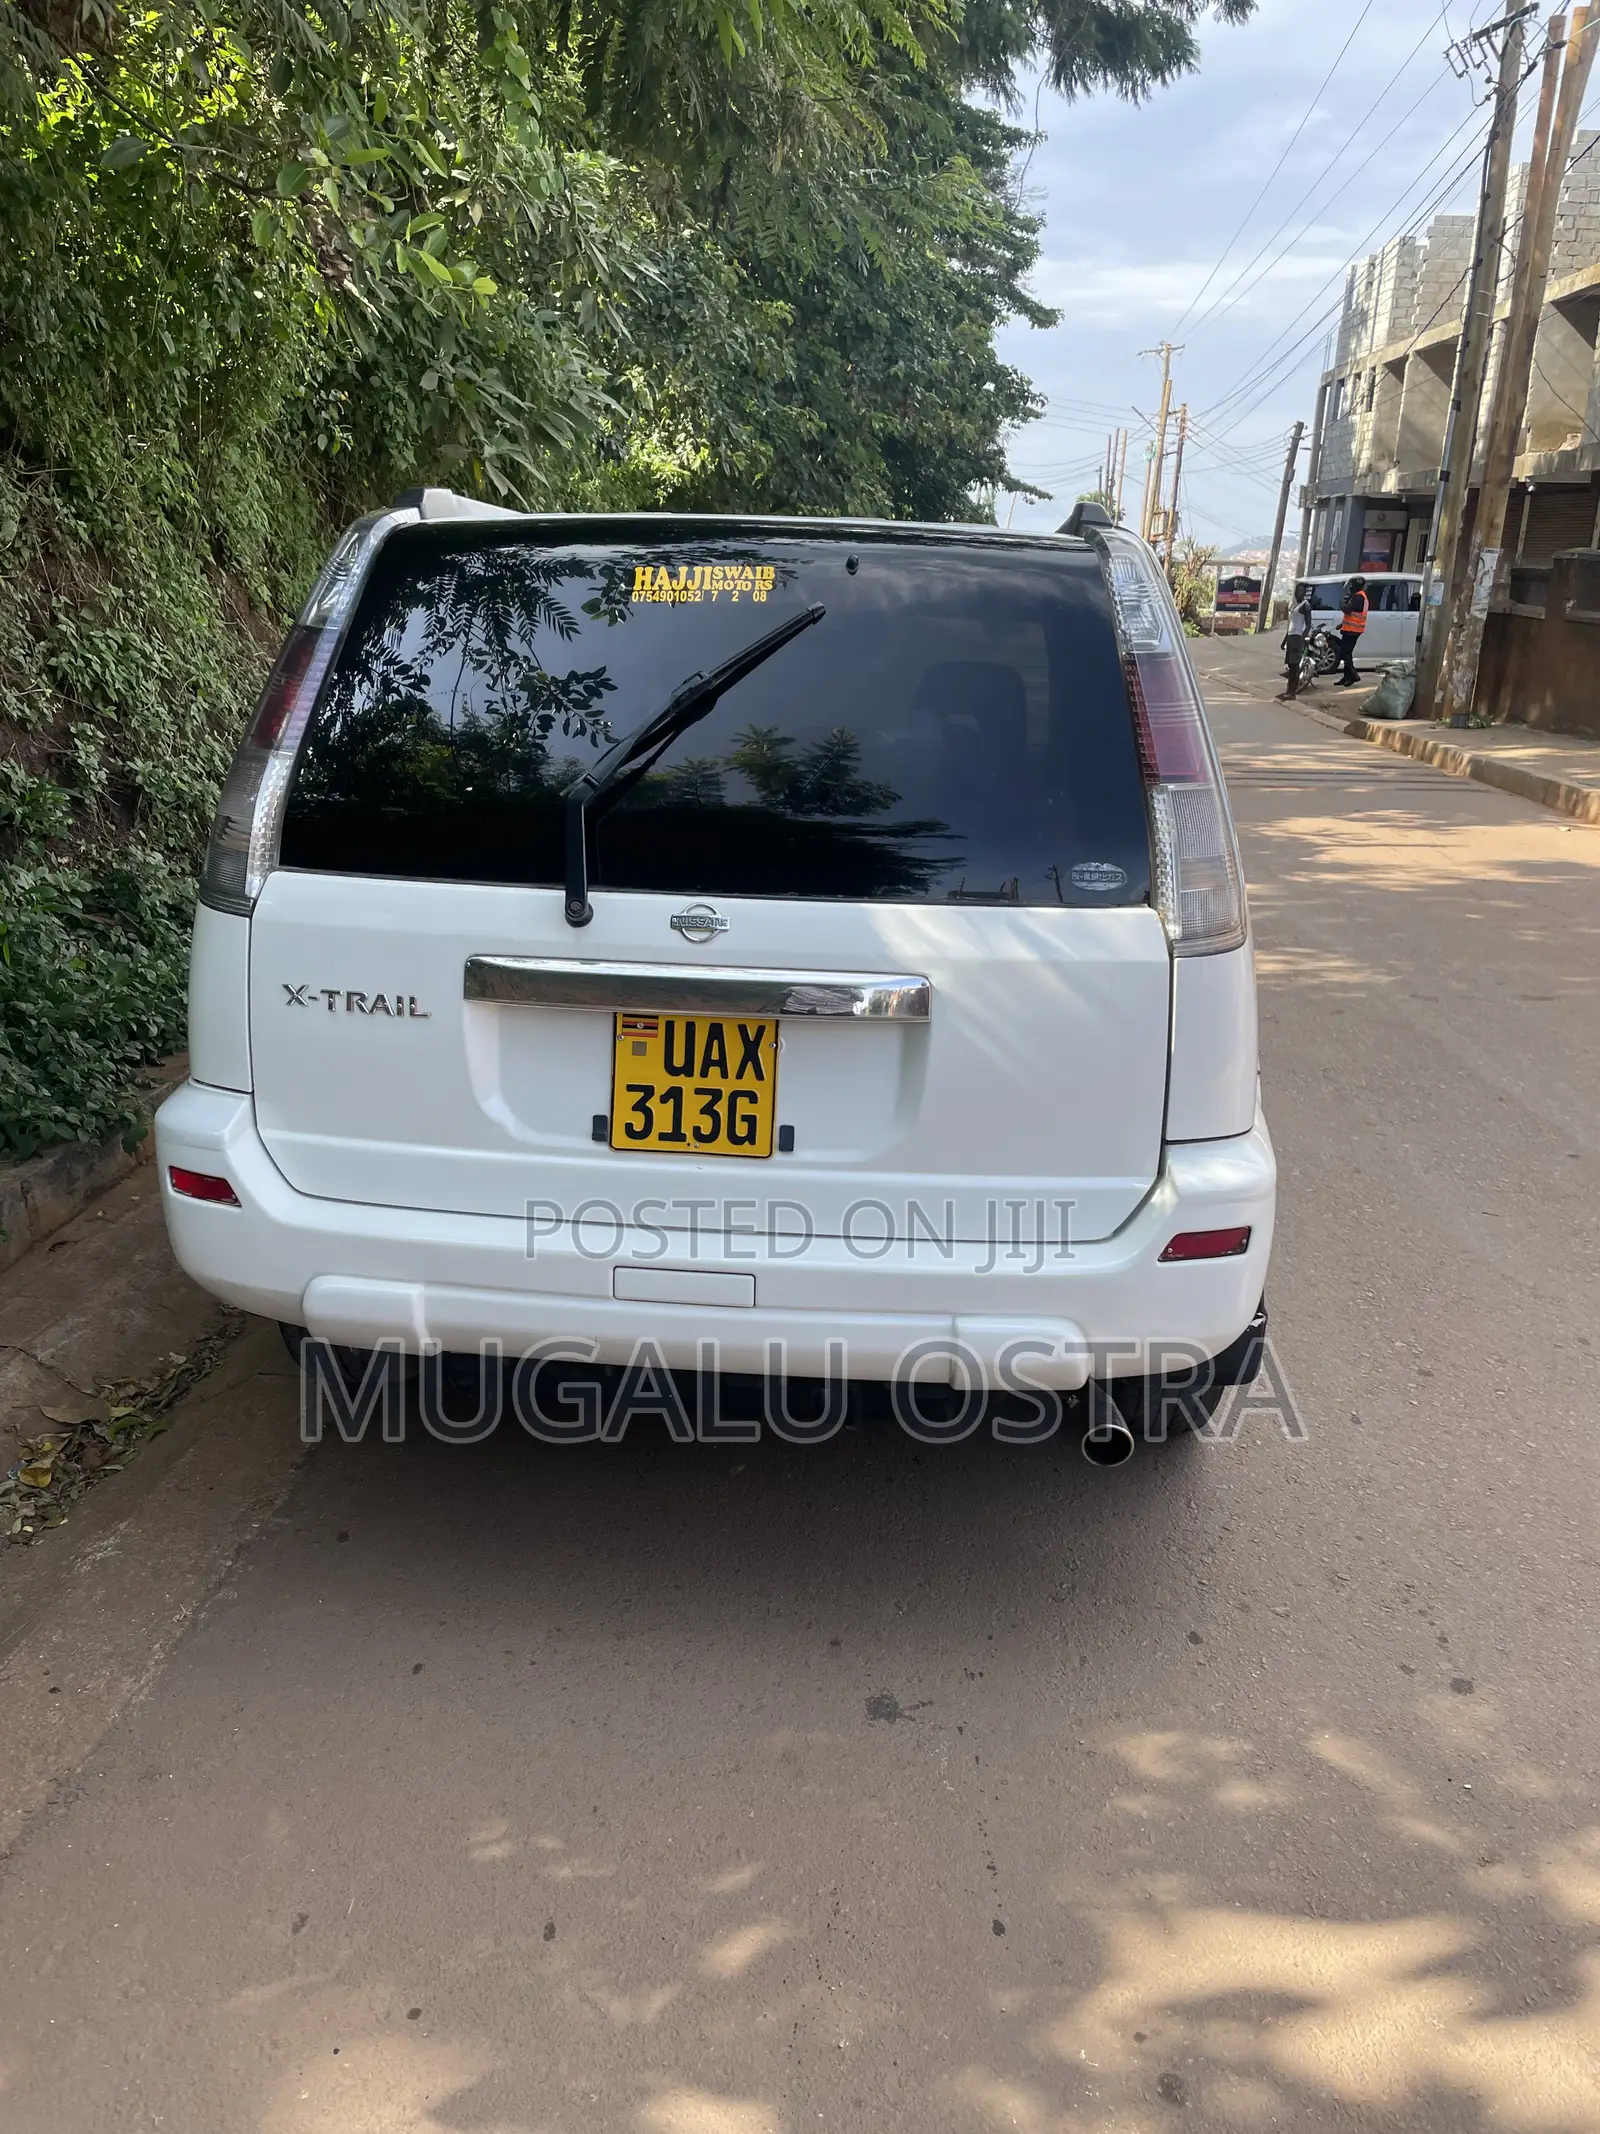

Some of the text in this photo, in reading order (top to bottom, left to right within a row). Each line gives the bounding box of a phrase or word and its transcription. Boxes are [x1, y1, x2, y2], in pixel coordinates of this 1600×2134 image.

[633, 566, 775, 590] HAJJI SWAIB
[676, 916, 723, 927] NISSAN
[281, 983, 432, 1018] X-TRAIL
[664, 1020, 766, 1081] UAX
[625, 1084, 759, 1146] 313G
